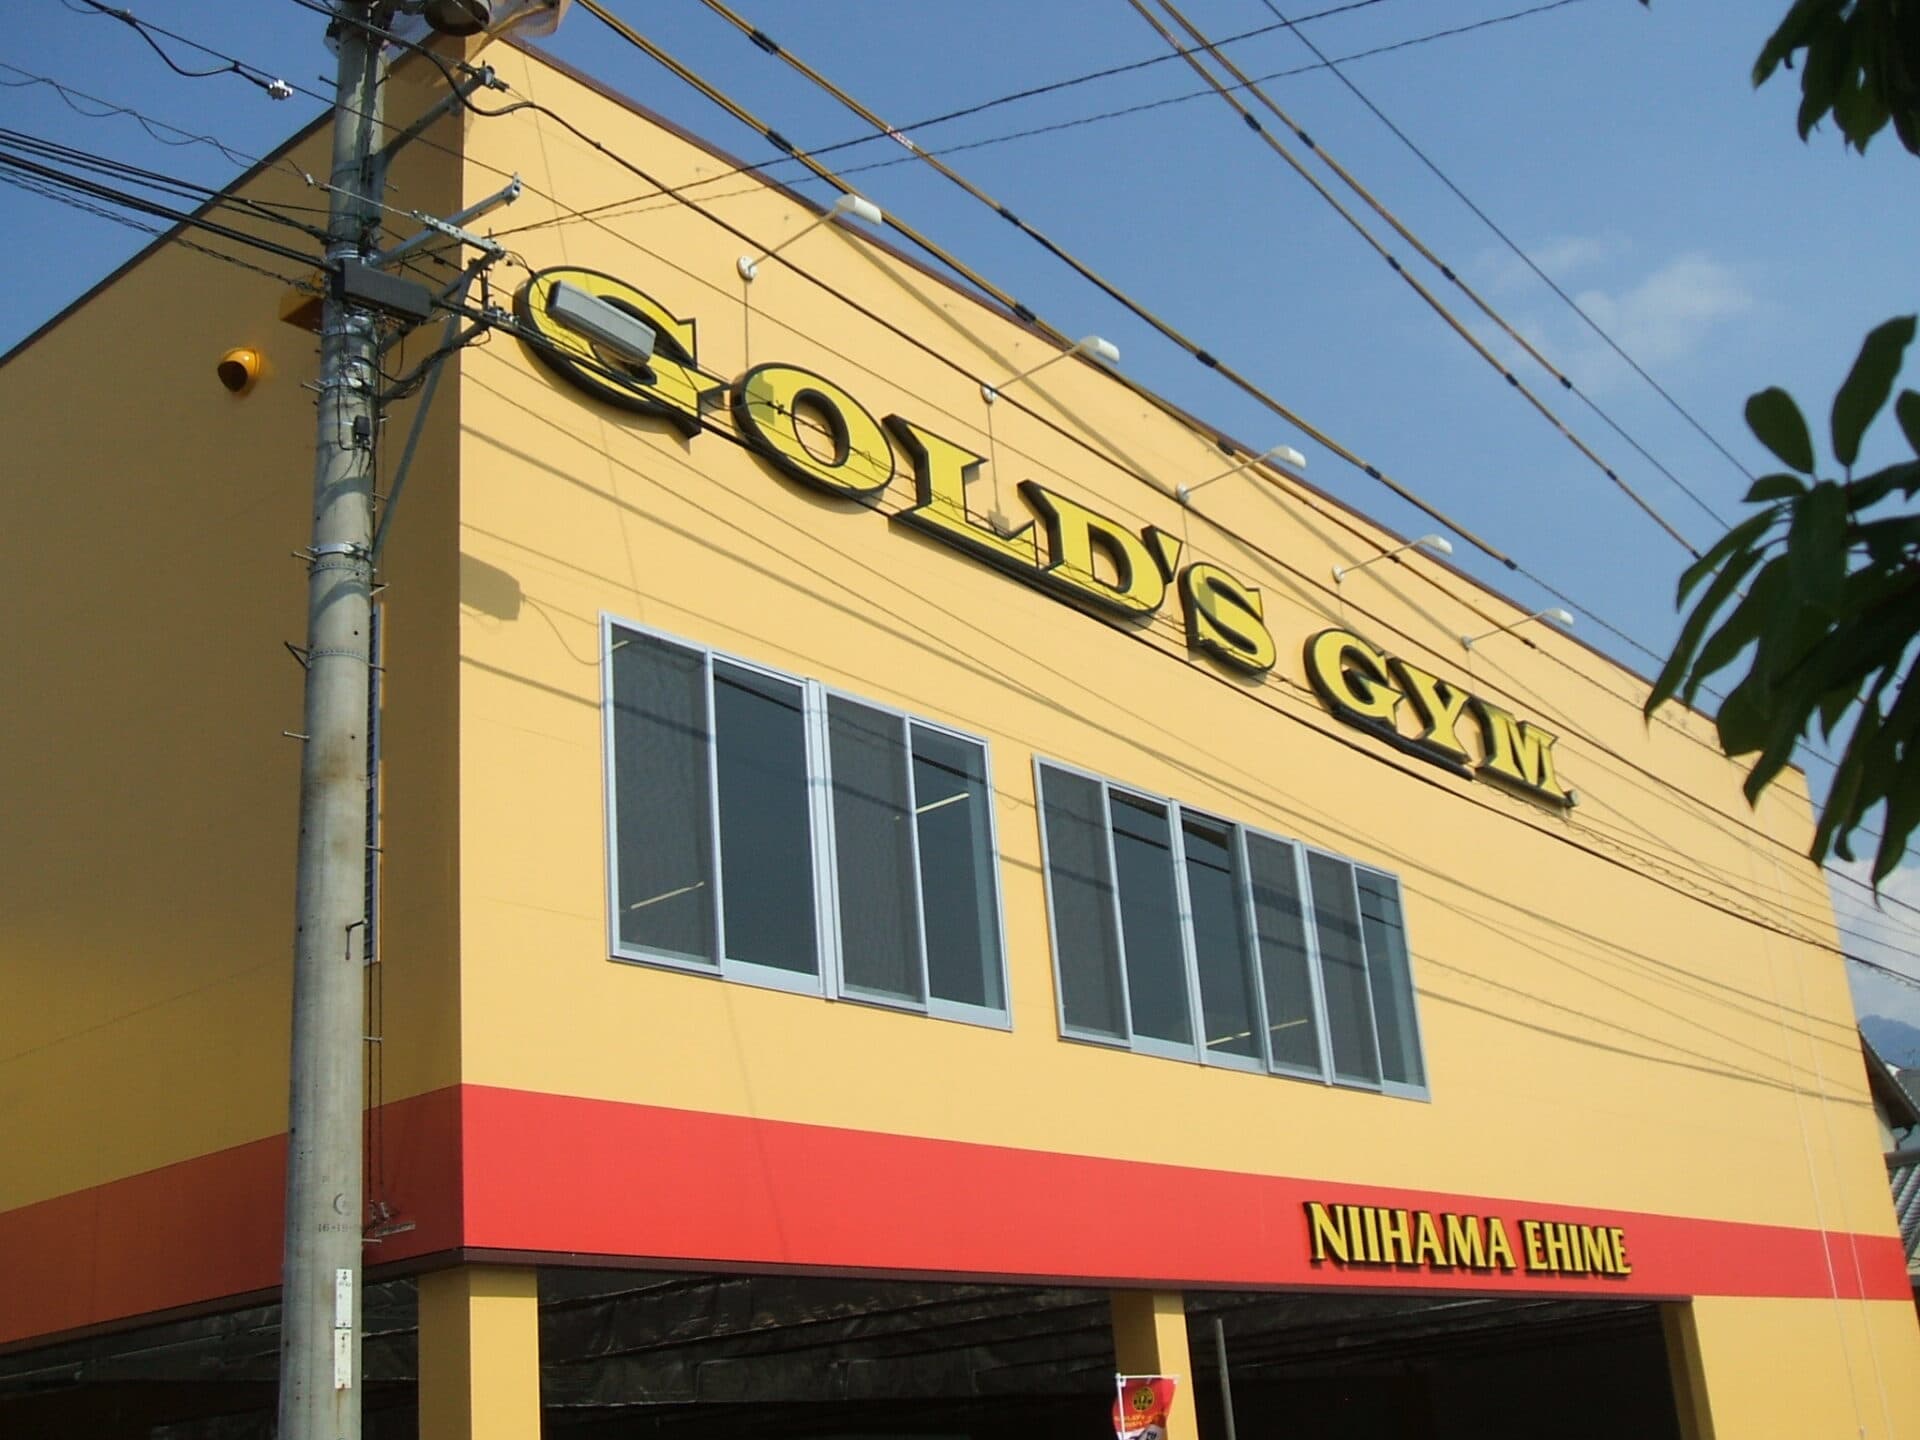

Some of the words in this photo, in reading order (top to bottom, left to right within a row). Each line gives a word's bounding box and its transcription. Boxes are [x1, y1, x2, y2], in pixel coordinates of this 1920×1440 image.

[513, 266, 1276, 671] GOLD'S
[1303, 629, 1576, 806] GYM
[1304, 1201, 1518, 1270] NIIHAMA
[1520, 1220, 1633, 1276] EHIME
